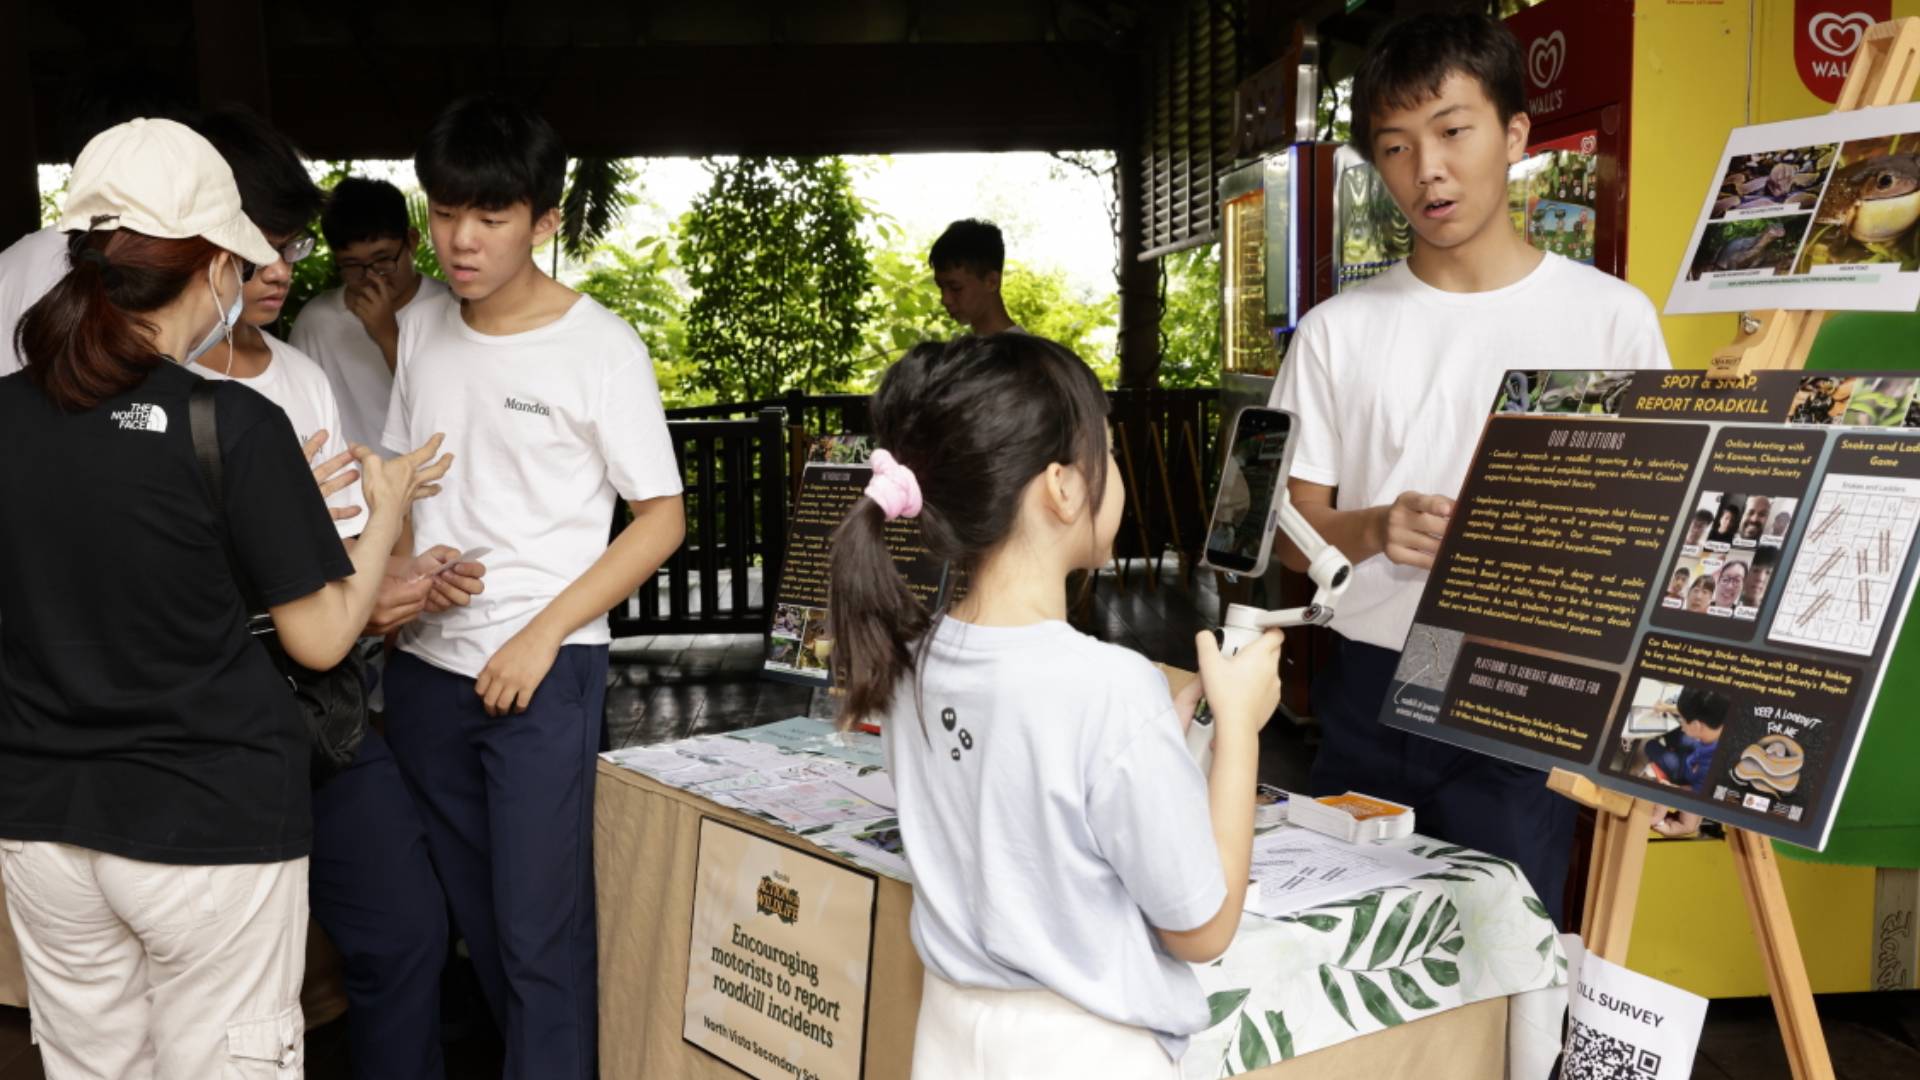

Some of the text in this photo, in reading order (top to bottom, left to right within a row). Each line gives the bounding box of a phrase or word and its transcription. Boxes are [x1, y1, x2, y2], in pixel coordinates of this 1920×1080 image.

[1812, 61, 1849, 78] WAL
[1661, 375, 1699, 389] SPOT
[131, 403, 152, 412] THE
[504, 397, 550, 416] Mandai
[1636, 396, 1769, 413] REPORT ROADKILL
[110, 411, 150, 421] NORTH
[118, 420, 147, 430] FACE
[1548, 430, 1626, 450] OUR SOLUTIONS
[1841, 439, 1920, 453] Snakes and Lad
[1870, 455, 1899, 467] Game
[1754, 706, 1822, 728] KEEP A LOOKOUT
[1768, 721, 1799, 738] FOR ME
[757, 894, 799, 922] WILDLIFE
[732, 922, 819, 987] Encouraging
[711, 945, 841, 1022] motorists to report
[713, 973, 834, 1050] roadkill incidents
[1598, 992, 1664, 1029] SURVEY
[703, 1015, 728, 1038] North
[729, 1029, 752, 1051] Vista
[752, 1041, 802, 1080] Secondary
